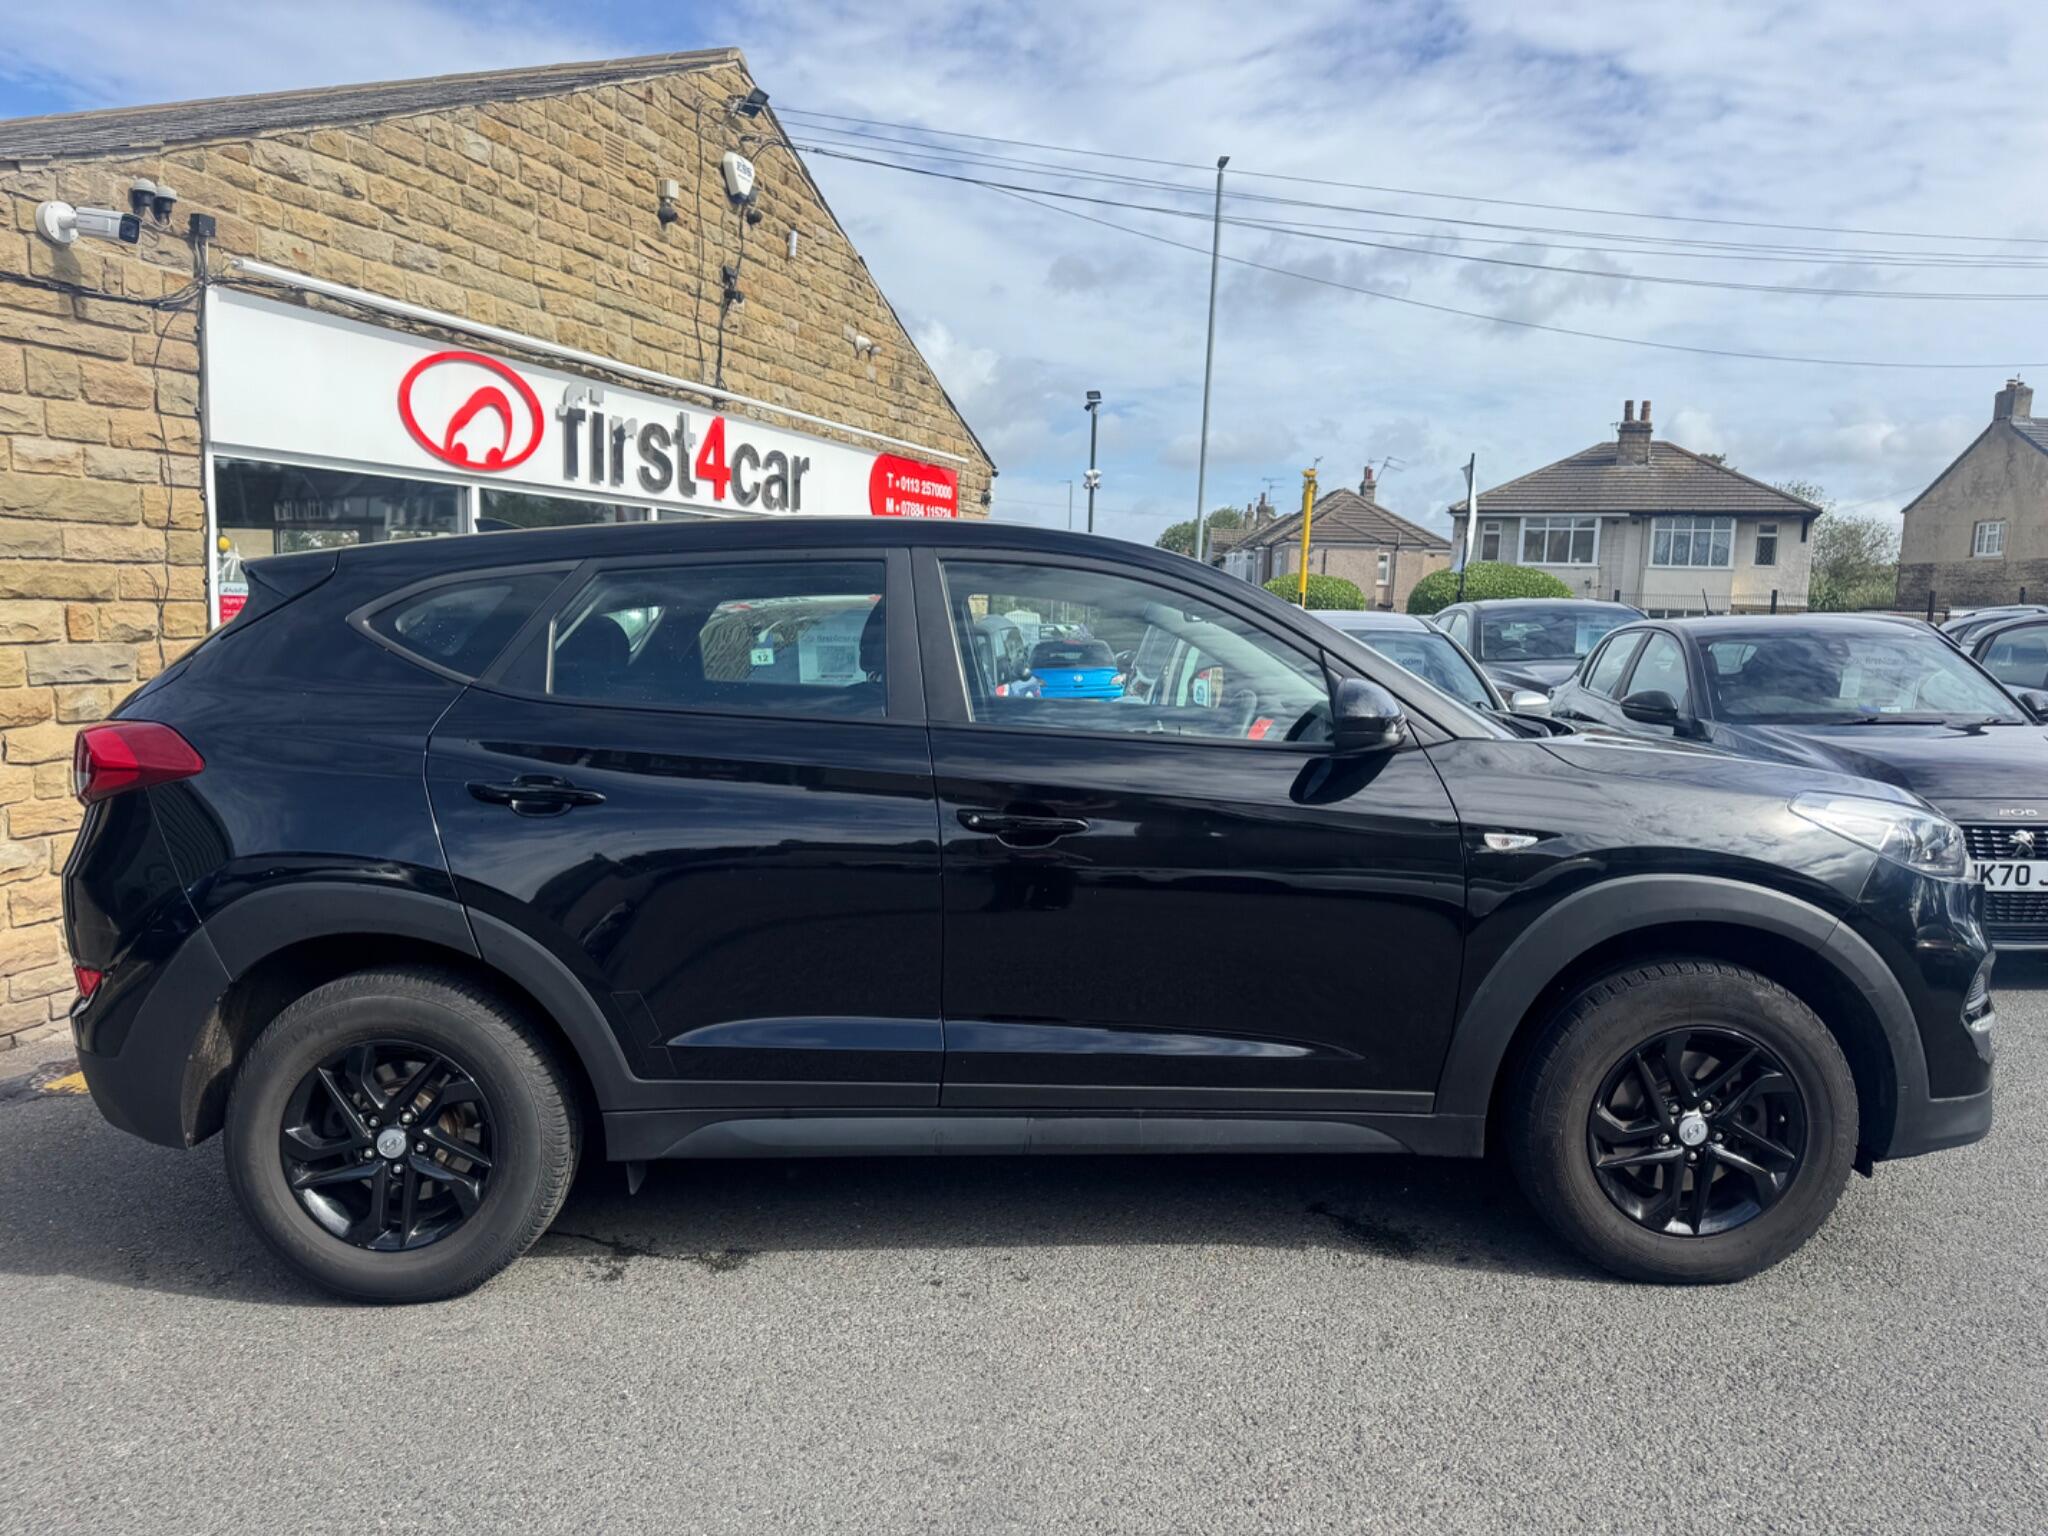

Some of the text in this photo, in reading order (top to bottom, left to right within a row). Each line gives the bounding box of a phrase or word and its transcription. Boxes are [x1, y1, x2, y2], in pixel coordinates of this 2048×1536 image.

[556, 382, 810, 512] first4car
[886, 471, 894, 489] T
[900, 475, 920, 494] 0113
[886, 497, 894, 513] M
